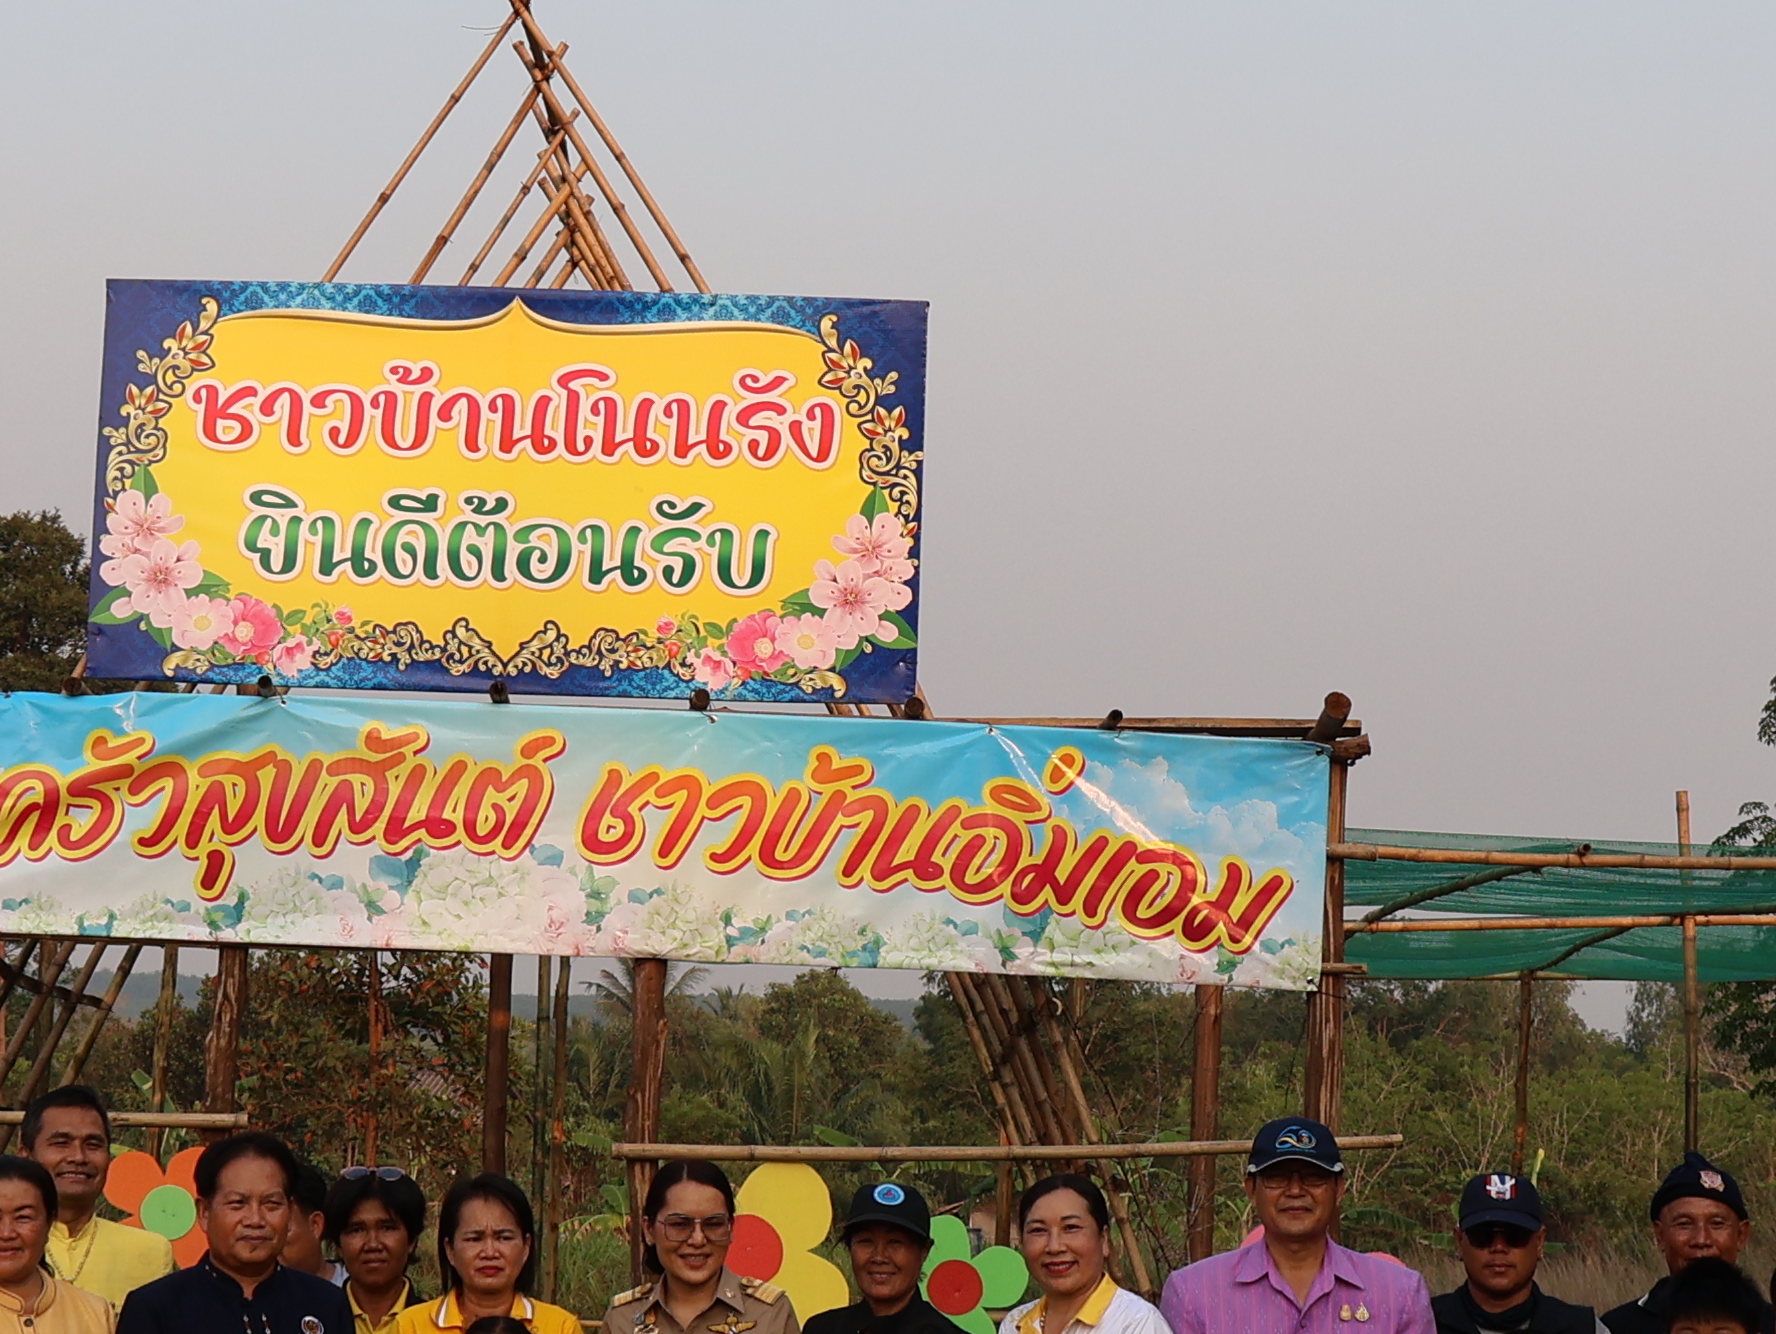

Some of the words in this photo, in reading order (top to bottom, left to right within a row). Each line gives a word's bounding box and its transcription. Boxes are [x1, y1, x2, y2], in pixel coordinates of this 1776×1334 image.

[187, 359, 840, 468] ชาวบ้านโนนรัง
[238, 487, 777, 595] ยินดีต้อนรับ
[577, 745, 1296, 956] ชาวบ้านอิ่มเอม
